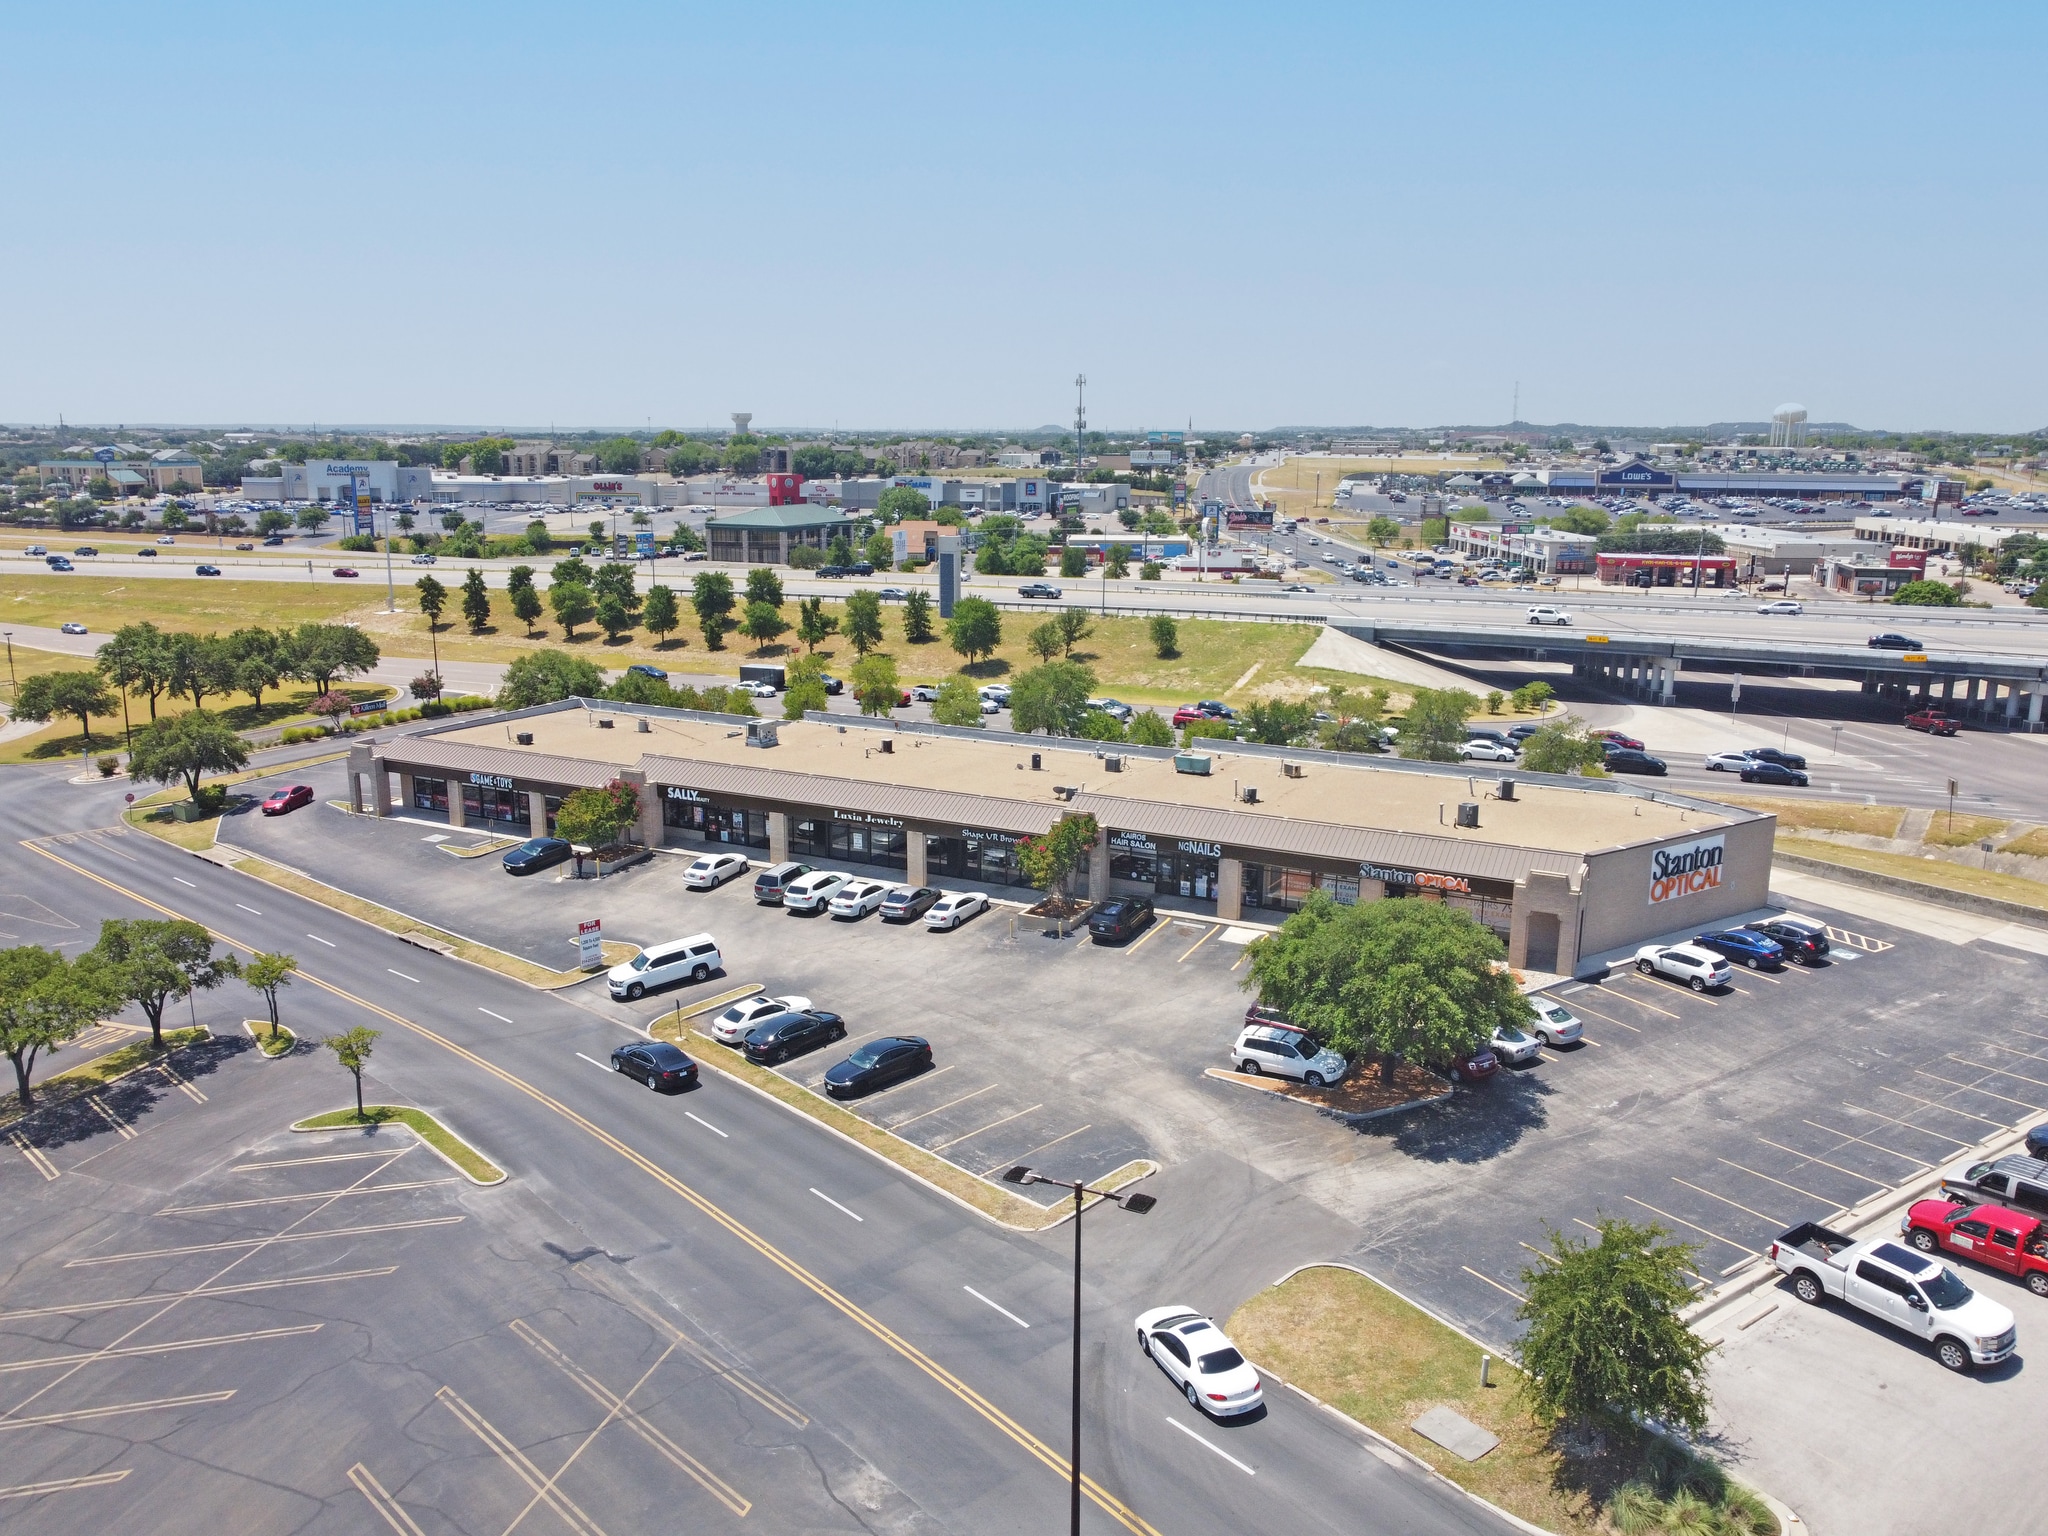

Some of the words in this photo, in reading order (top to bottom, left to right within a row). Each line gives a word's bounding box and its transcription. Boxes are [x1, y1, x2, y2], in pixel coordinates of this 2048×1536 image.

[326, 463, 369, 473] Academy
[1622, 471, 1652, 480] LOWE'S
[496, 777, 513, 789] TOYS
[667, 787, 699, 801] SALLY
[834, 810, 862, 822] Luxia
[865, 814, 905, 829] Jewelry
[962, 829, 985, 840] Shape
[1120, 831, 1147, 841] KAIROS
[1111, 837, 1129, 847] HAIR
[1130, 840, 1156, 850] SALON
[1652, 845, 1724, 881] Stanton
[1360, 863, 1416, 885] Stanton
[1415, 872, 1472, 893] OPTICAL
[1650, 866, 1722, 902] OPTICAL
[584, 920, 596, 928] FOR
[580, 926, 599, 935] LEASE
